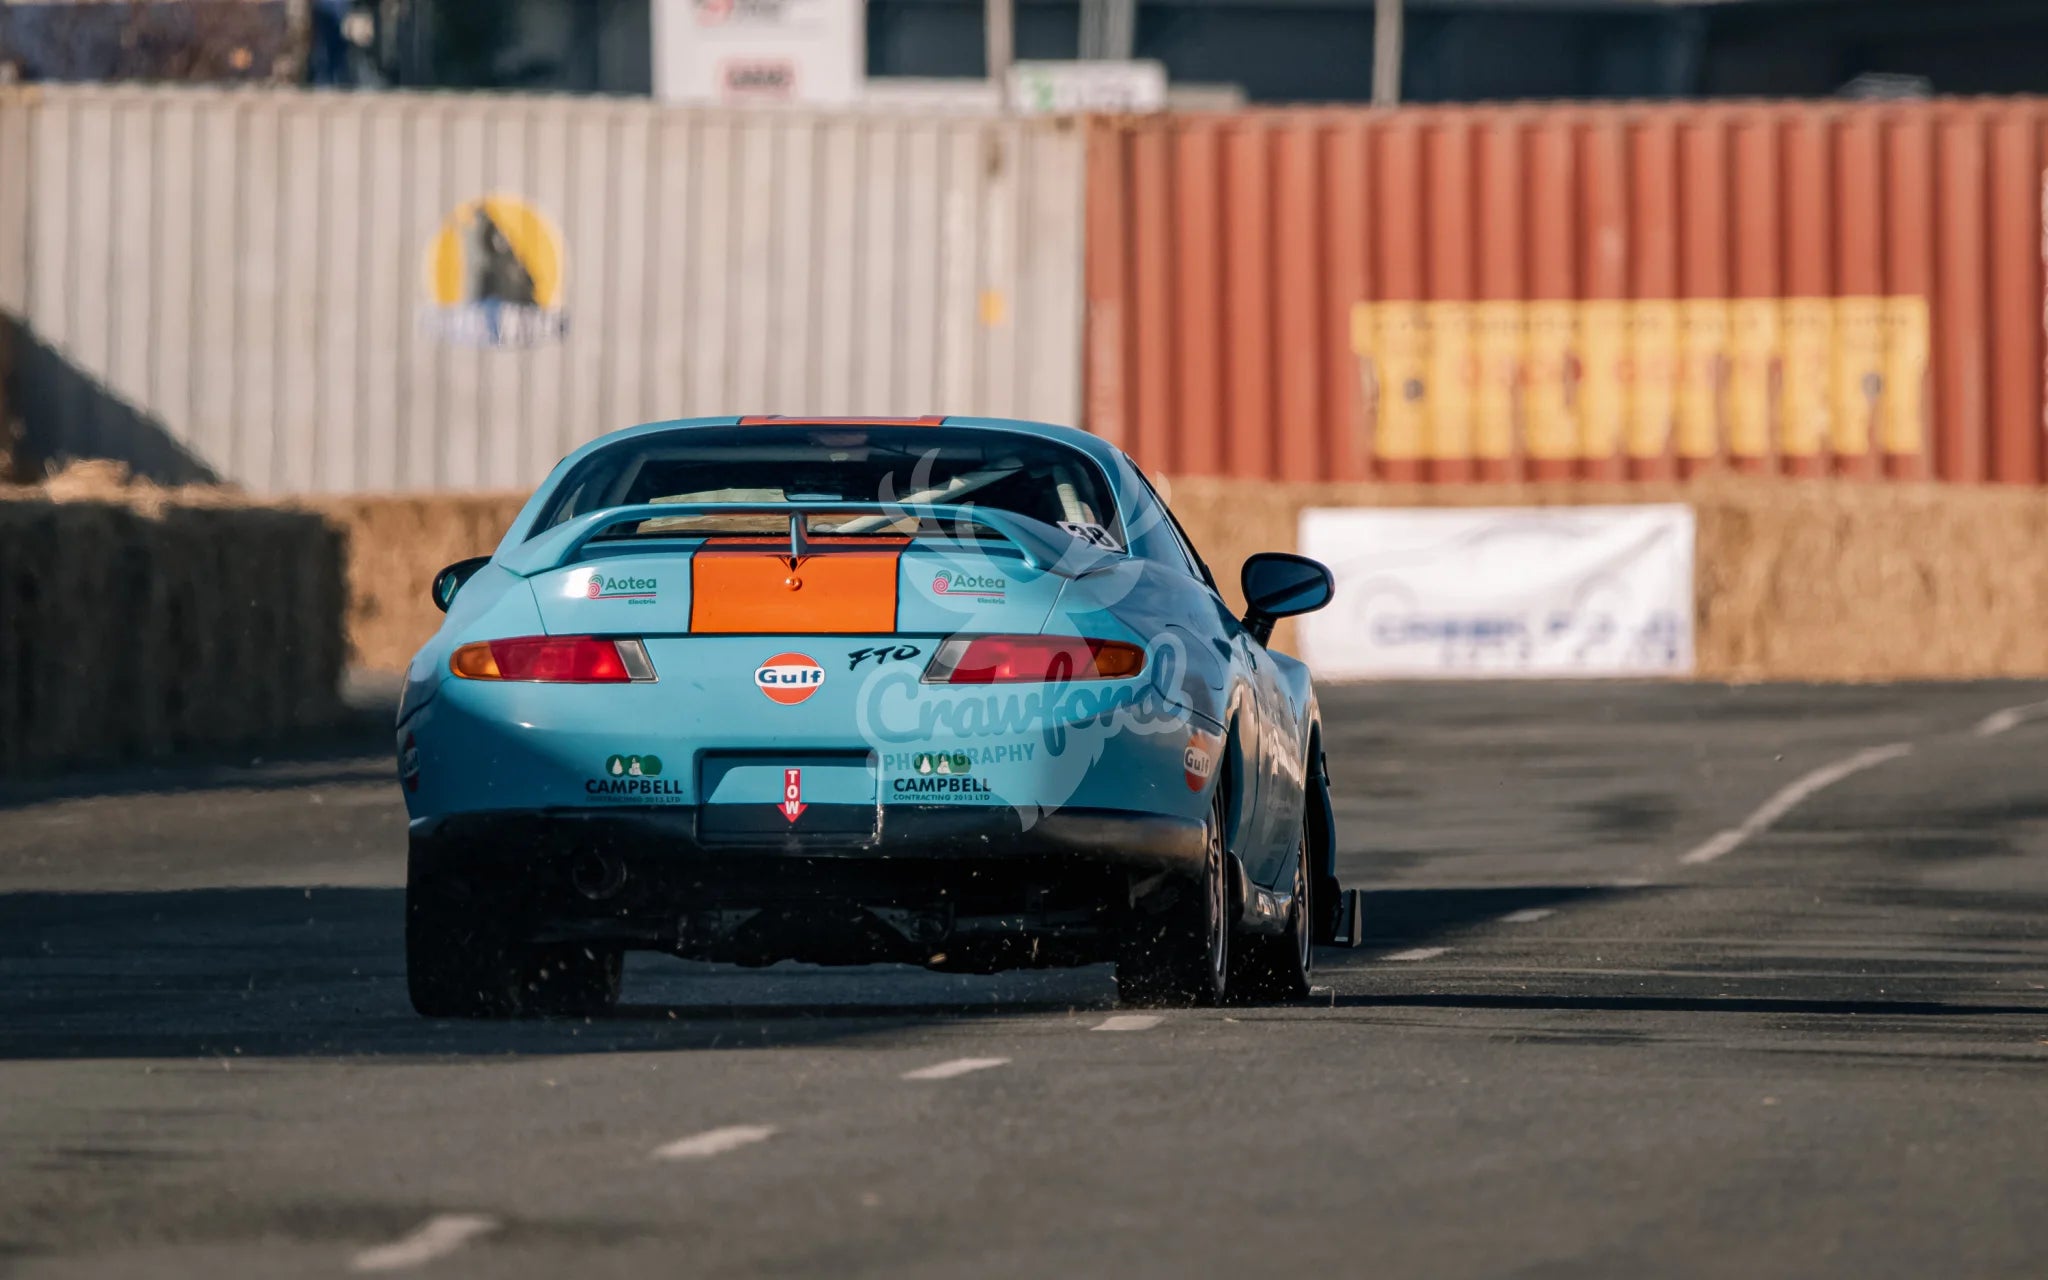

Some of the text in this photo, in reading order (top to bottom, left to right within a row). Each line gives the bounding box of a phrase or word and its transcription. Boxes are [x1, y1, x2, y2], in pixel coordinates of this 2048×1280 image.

[605, 576, 657, 591] Aotea
[953, 574, 1006, 589] Aotea
[848, 644, 921, 671] FTO
[757, 668, 822, 684] Gulf
[1184, 748, 1210, 775] Gulf
[585, 778, 684, 794] CAMPBELL
[785, 770, 800, 815] TOW
[893, 777, 992, 793] CAMPBELL
[893, 793, 991, 801] CONTRACTING 2013 LTD
